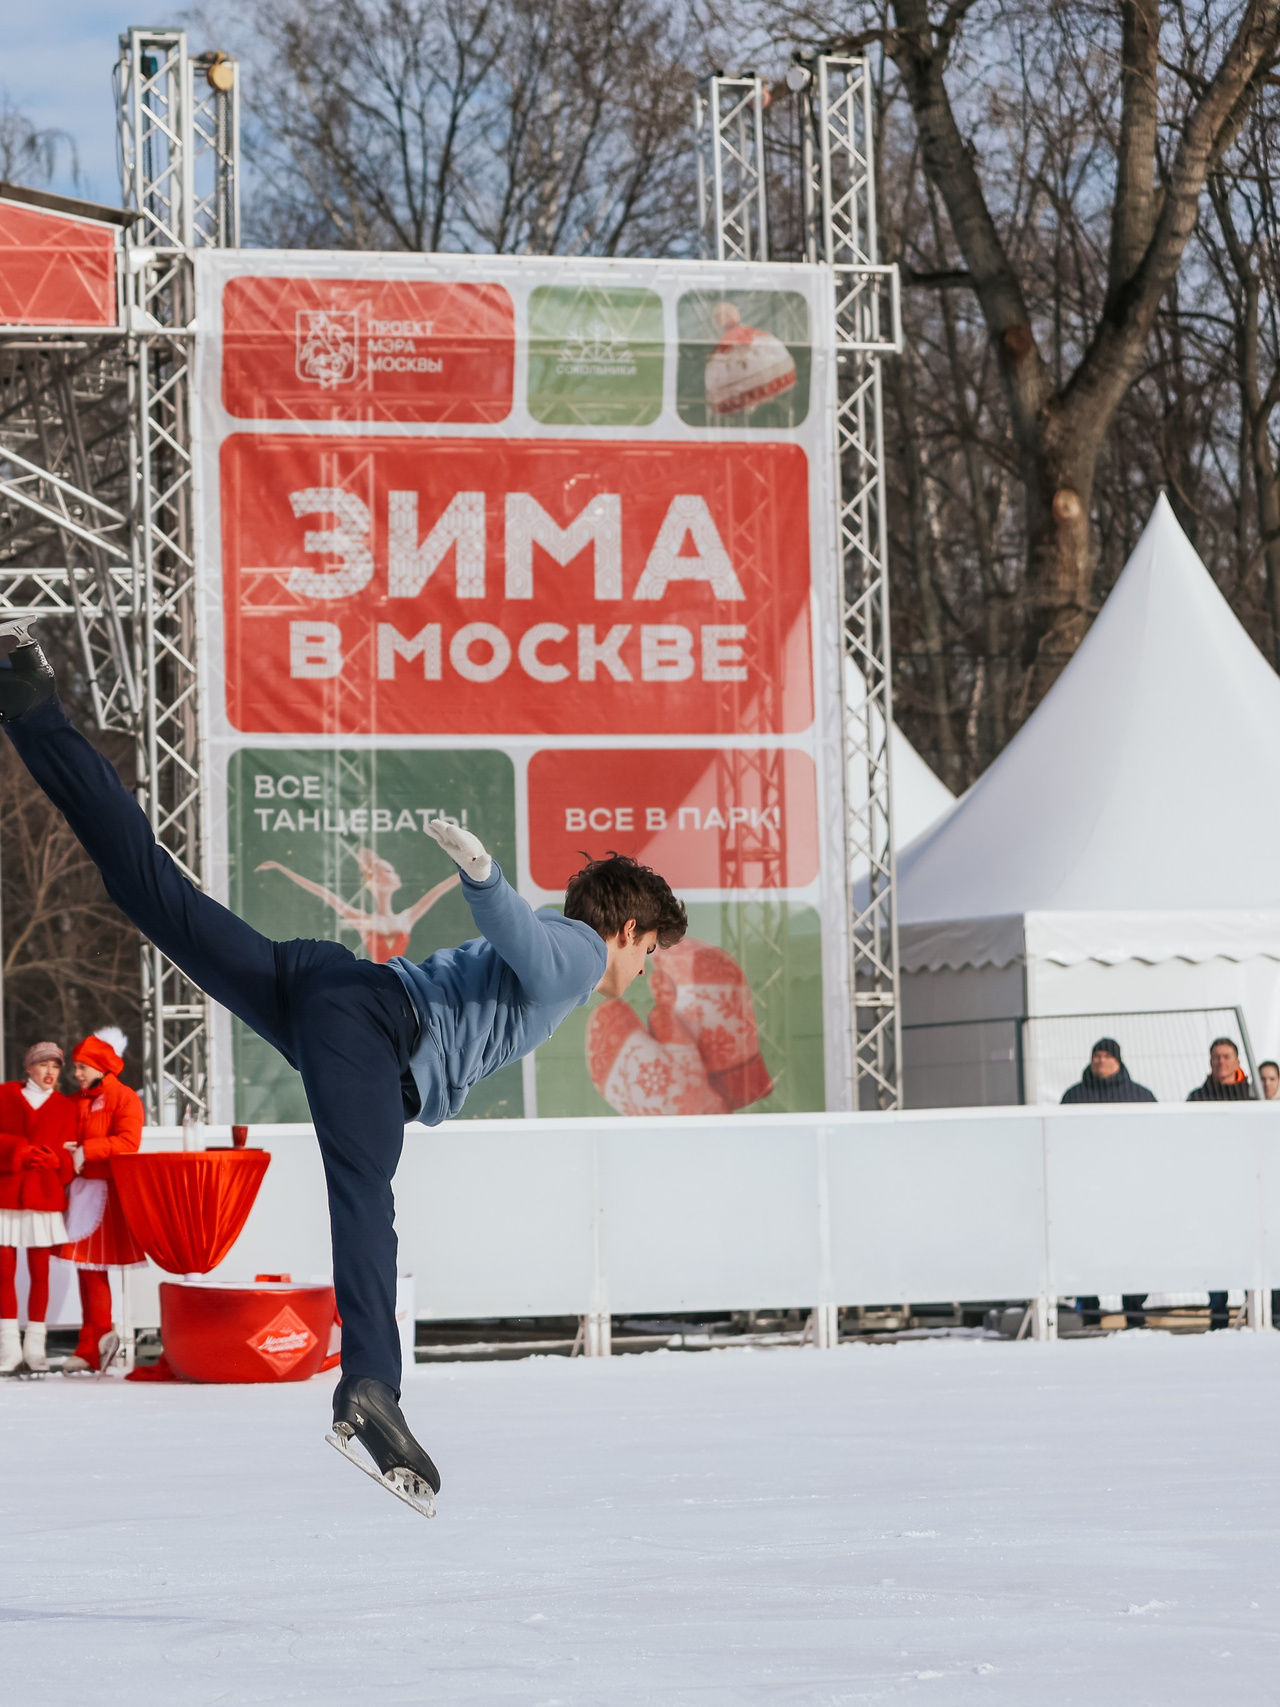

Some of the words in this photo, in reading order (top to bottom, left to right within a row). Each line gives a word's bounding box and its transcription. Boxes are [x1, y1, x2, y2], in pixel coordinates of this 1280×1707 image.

[368, 320, 434, 337] ПРОЕКТ
[368, 339, 417, 354] МЭРА
[368, 356, 443, 374] МОСКВЫ
[556, 364, 637, 376] СОКОЛЬНИКИ
[287, 487, 746, 601] ЗИМА
[289, 620, 344, 679] В
[377, 621, 747, 682] МОСКВЕ
[254, 775, 321, 799] ВСЕ
[565, 808, 634, 831] ВСЕ
[645, 808, 668, 831] В
[678, 807, 780, 831] ПАРК!
